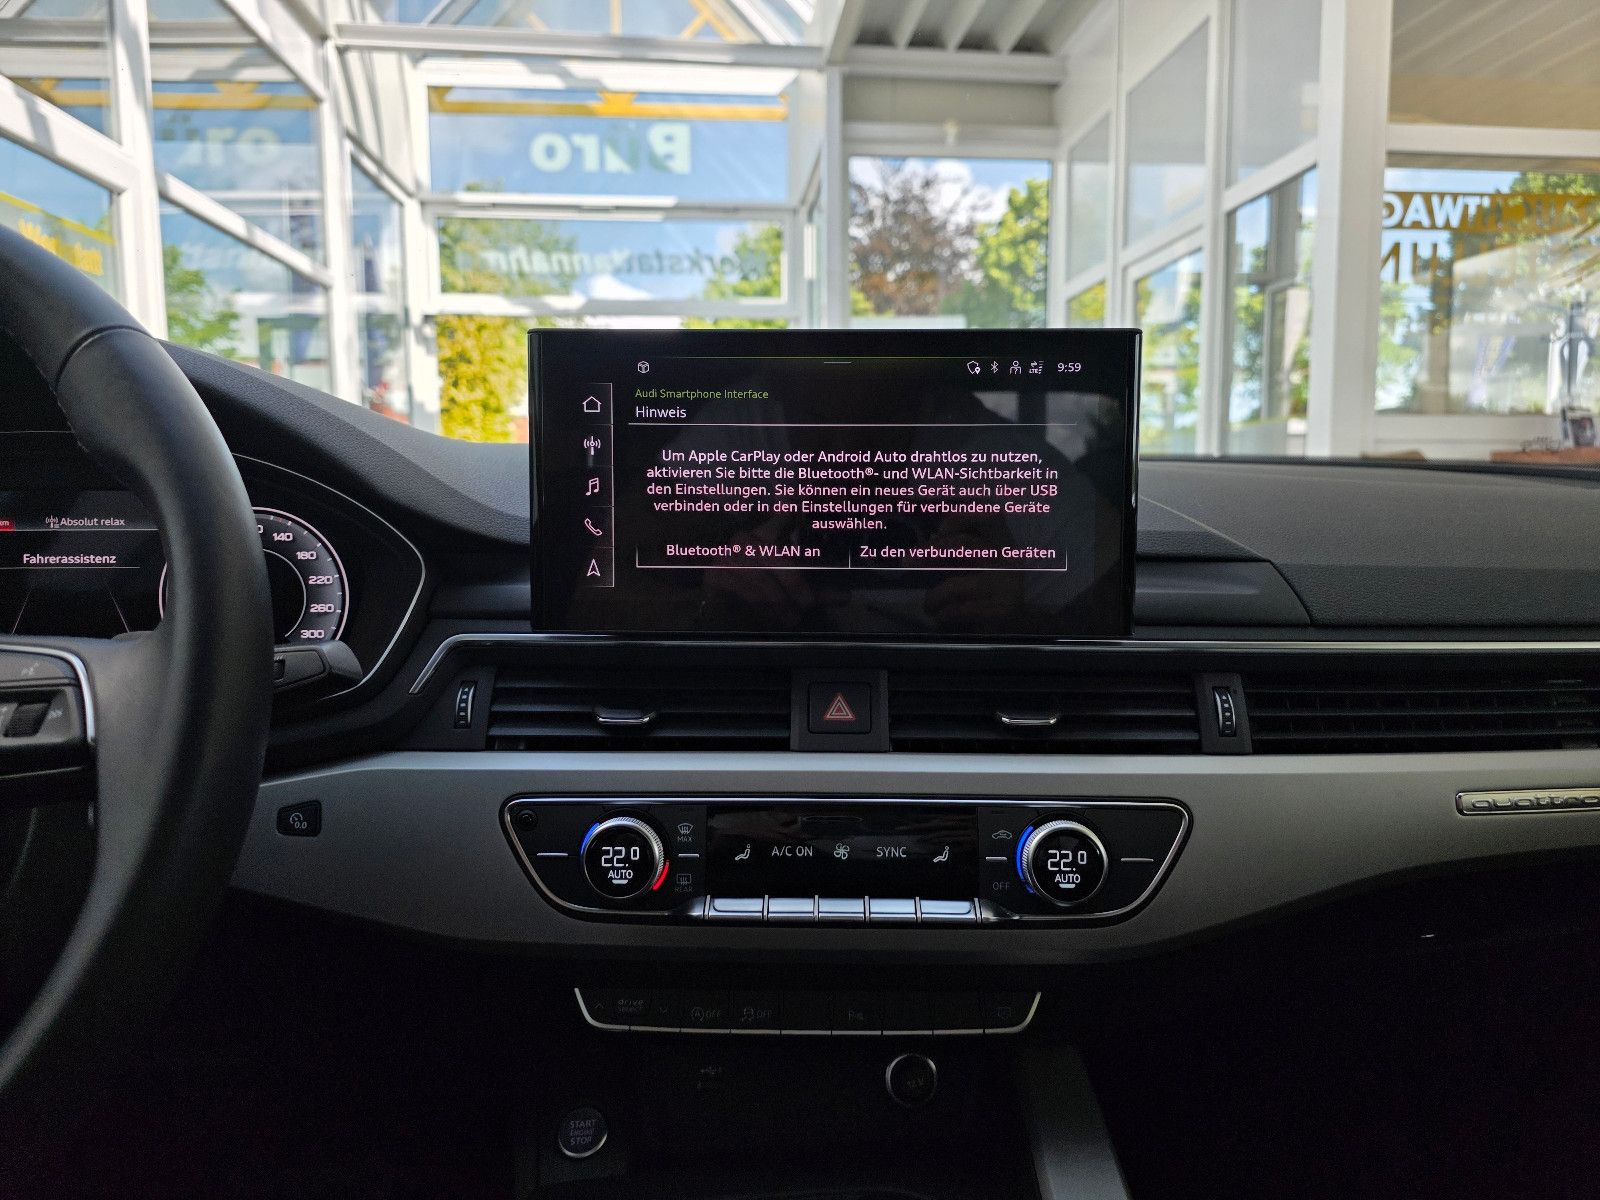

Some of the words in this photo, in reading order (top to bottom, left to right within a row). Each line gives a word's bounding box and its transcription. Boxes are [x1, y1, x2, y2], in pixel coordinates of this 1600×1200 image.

[1057, 362, 1082, 373] 9:59
[634, 388, 658, 399] Audi
[659, 388, 722, 401] Smartphone
[724, 389, 769, 400] Interface
[635, 405, 687, 419] Hinweis
[662, 449, 685, 462] Um
[688, 449, 728, 465] Apple
[730, 449, 781, 465] CarPlay
[783, 450, 815, 463] oder
[817, 450, 871, 463] Android
[873, 450, 907, 463] Auto
[910, 450, 968, 463] drahtlos
[970, 453, 987, 463] zu
[990, 451, 1043, 465] nutzen,
[646, 465, 712, 479] aktivieren
[715, 466, 736, 479] Sie
[739, 466, 771, 479] bitte
[774, 466, 795, 479] die
[883, 467, 909, 480] und
[911, 467, 1043, 480] WLAN-Sichtbarkeit
[1045, 467, 1058, 480] in
[646, 482, 672, 495] den
[675, 483, 771, 499] Einstellungen.
[774, 483, 795, 496] Sie
[798, 483, 847, 496] können
[850, 484, 871, 496] ein
[874, 486, 915, 496] neues
[917, 484, 956, 497] Gerät
[958, 483, 991, 497] auch
[995, 483, 1027, 497] über
[1030, 484, 1058, 497] USB
[653, 499, 720, 512] verbinden
[723, 499, 755, 512] oder
[757, 500, 770, 513] in
[773, 500, 798, 513] den
[801, 500, 893, 516] Einstellungen
[896, 500, 918, 513] für
[919, 500, 1001, 513] verbundene
[1004, 501, 1051, 513] Geräte
[60, 517, 98, 526] Absolut
[100, 517, 125, 526] relax
[811, 516, 887, 530] auswählen.
[272, 532, 293, 542] 140
[296, 551, 317, 560] 180
[744, 544, 757, 557] &
[758, 544, 801, 557] WLAN
[804, 547, 821, 557] an
[859, 545, 877, 558] Zu
[880, 545, 906, 558] den
[909, 545, 998, 558] verbundenen
[1001, 546, 1056, 559] Geräten
[23, 553, 117, 564] Fahrerassistenz
[308, 575, 333, 585] 220
[309, 603, 335, 613] 260
[300, 629, 325, 639] 300
[294, 821, 308, 829] 0.0
[601, 846, 640, 867] 22.0
[771, 845, 792, 857] A/C
[795, 846, 813, 857] ON
[876, 846, 907, 858] SYNC
[1047, 850, 1087, 871] 22.0
[607, 869, 634, 879] AUTO
[1054, 873, 1081, 883] AUTO
[992, 881, 1011, 891] OFF
[568, 1119, 597, 1129] START
[570, 1136, 593, 1146] STOP
